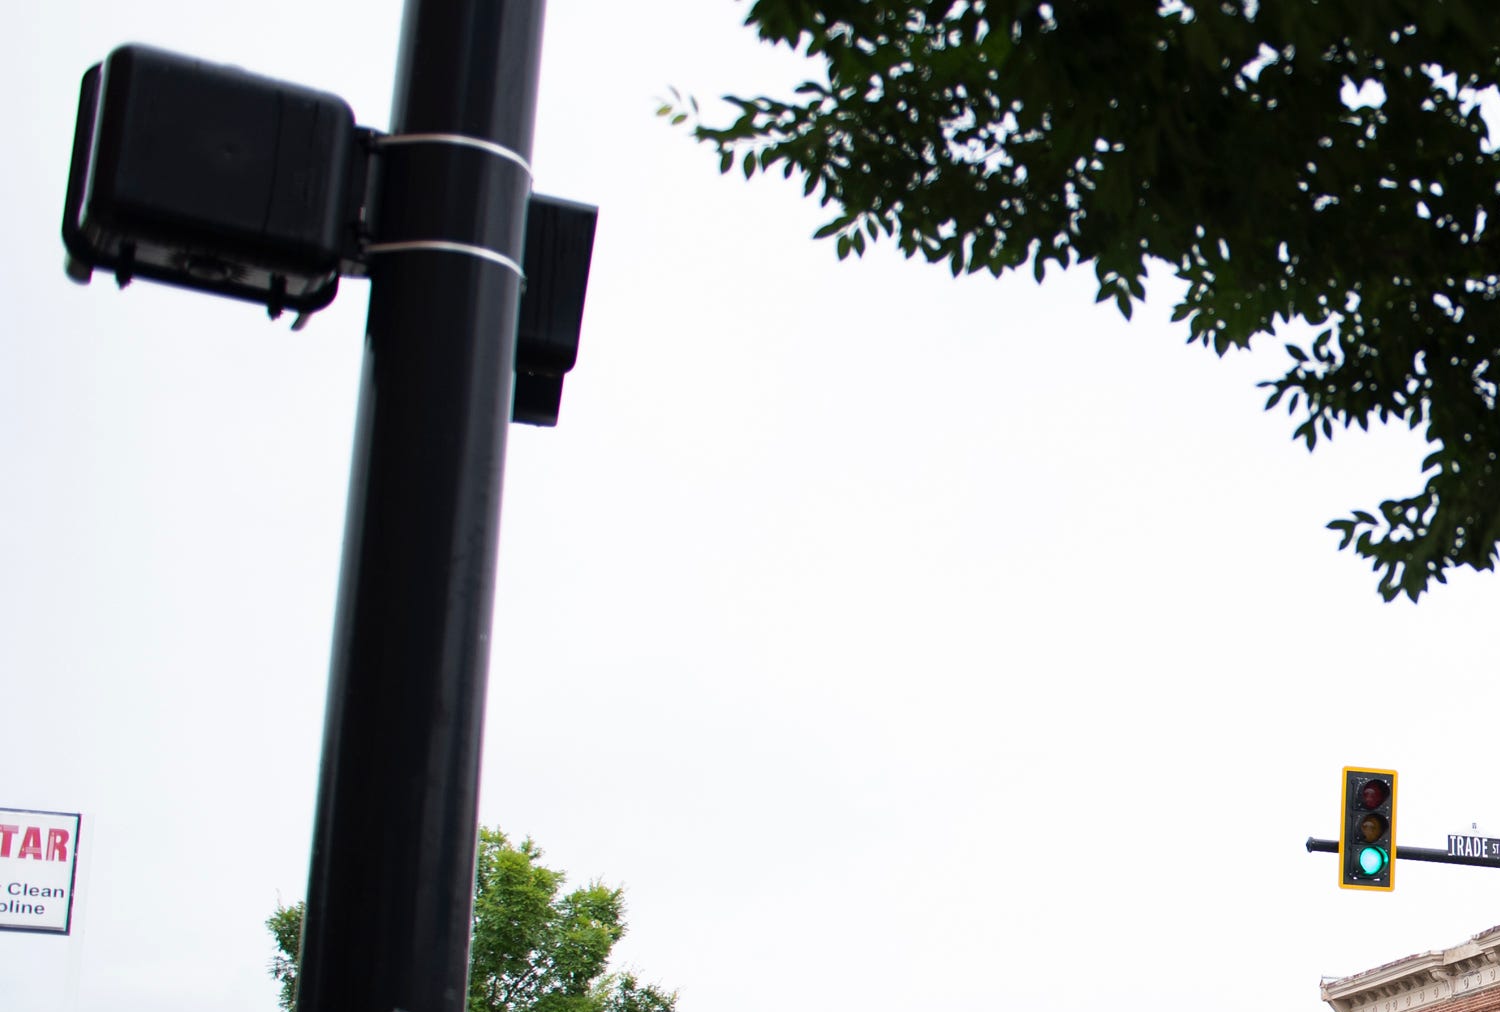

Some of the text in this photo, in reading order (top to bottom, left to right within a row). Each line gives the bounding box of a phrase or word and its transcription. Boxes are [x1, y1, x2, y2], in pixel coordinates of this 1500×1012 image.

[1449, 835, 1500, 858] TRADE ST
[7, 882, 65, 899] Clean
